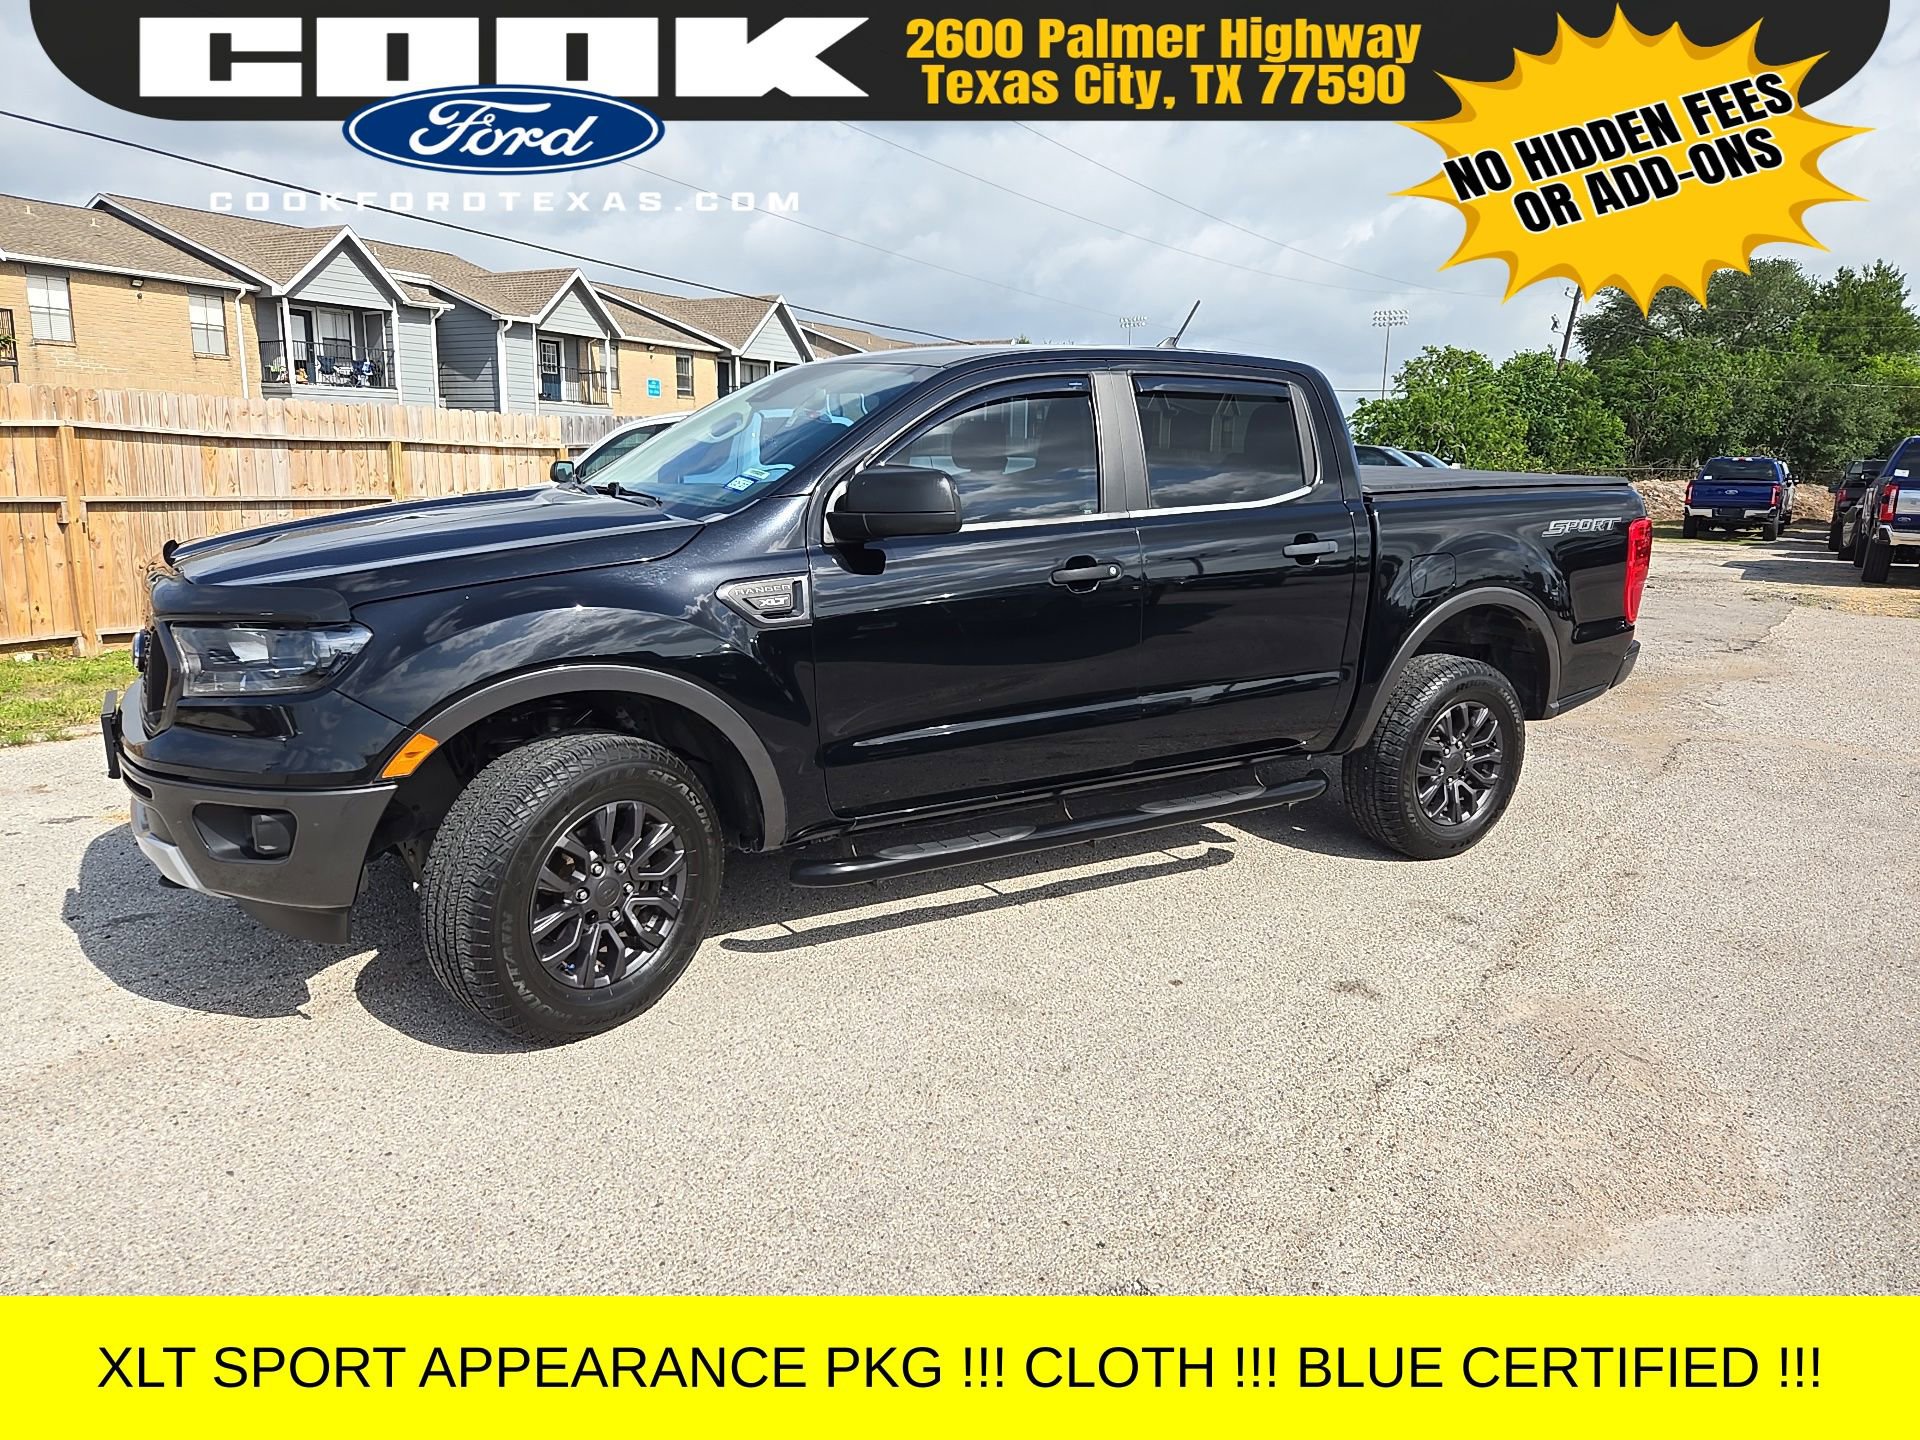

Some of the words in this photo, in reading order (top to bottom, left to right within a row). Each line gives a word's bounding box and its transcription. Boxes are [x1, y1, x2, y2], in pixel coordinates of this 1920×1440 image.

[1541, 517, 1622, 537] SPORT
[734, 584, 792, 596] RANGER
[759, 597, 789, 607] XLT
